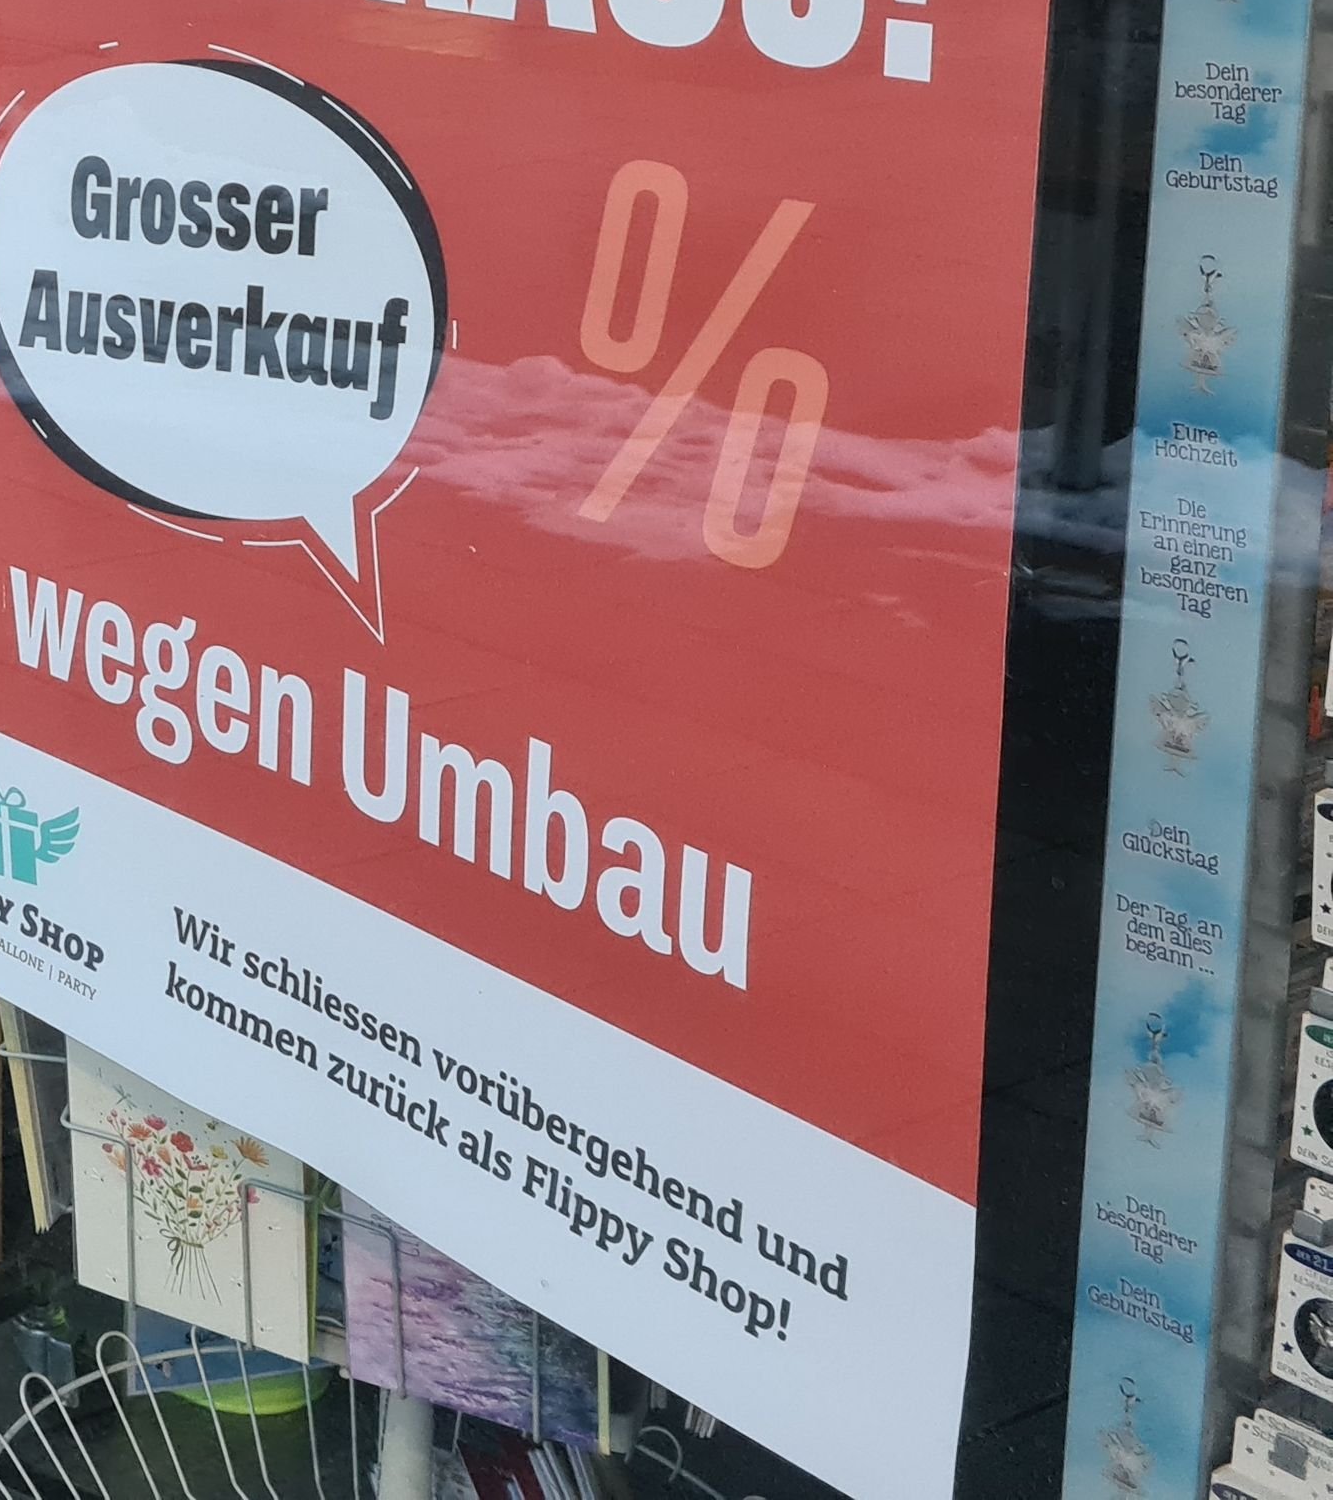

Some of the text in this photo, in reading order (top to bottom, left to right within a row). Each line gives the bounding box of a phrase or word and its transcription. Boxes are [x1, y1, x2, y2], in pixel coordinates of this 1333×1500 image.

[1205, 62, 1249, 82] Dein
[1175, 82, 1282, 103] besonderer
[1211, 103, 1246, 124] Tag
[1200, 153, 1242, 172] Dein
[1165, 170, 1278, 197] Geburtstag
[70, 154, 328, 257] Grosser
[20, 268, 408, 419] Ausverkauf
[1173, 422, 1218, 445] Eure
[1155, 440, 1237, 468] Hochzeit
[1177, 499, 1206, 519] Die
[1140, 512, 1247, 548] Erinnerung
[1154, 534, 1233, 562] an einen
[1171, 557, 1216, 578] ganz
[1141, 568, 1249, 604] besonderen
[1177, 592, 1211, 618] Tag
[10, 566, 752, 992] wegen Umbau
[1149, 819, 1190, 846] Dein
[1122, 832, 1219, 876] Glückstag
[1116, 893, 1151, 918] Der
[1197, 919, 1223, 940] an
[1125, 935, 1194, 970] begann
[1127, 918, 1213, 956] dem alles
[58, 972, 97, 1001] PARTY
[173, 906, 236, 968] Wir
[243, 948, 421, 1068] schliessen
[433, 1048, 742, 1243] vorübergehend
[759, 1224, 848, 1300] und
[165, 962, 317, 1071] kommen
[327, 1053, 448, 1147] zurück
[458, 1129, 512, 1182] als
[523, 1155, 652, 1268] Flippy
[664, 1239, 792, 1343] Shop!
[1126, 1195, 1167, 1227] Dein
[1095, 1202, 1198, 1255] besonderer
[1130, 1234, 1165, 1264] Tag
[1119, 1278, 1160, 1309] Dein
[1088, 1285, 1194, 1345] Geburtstag
